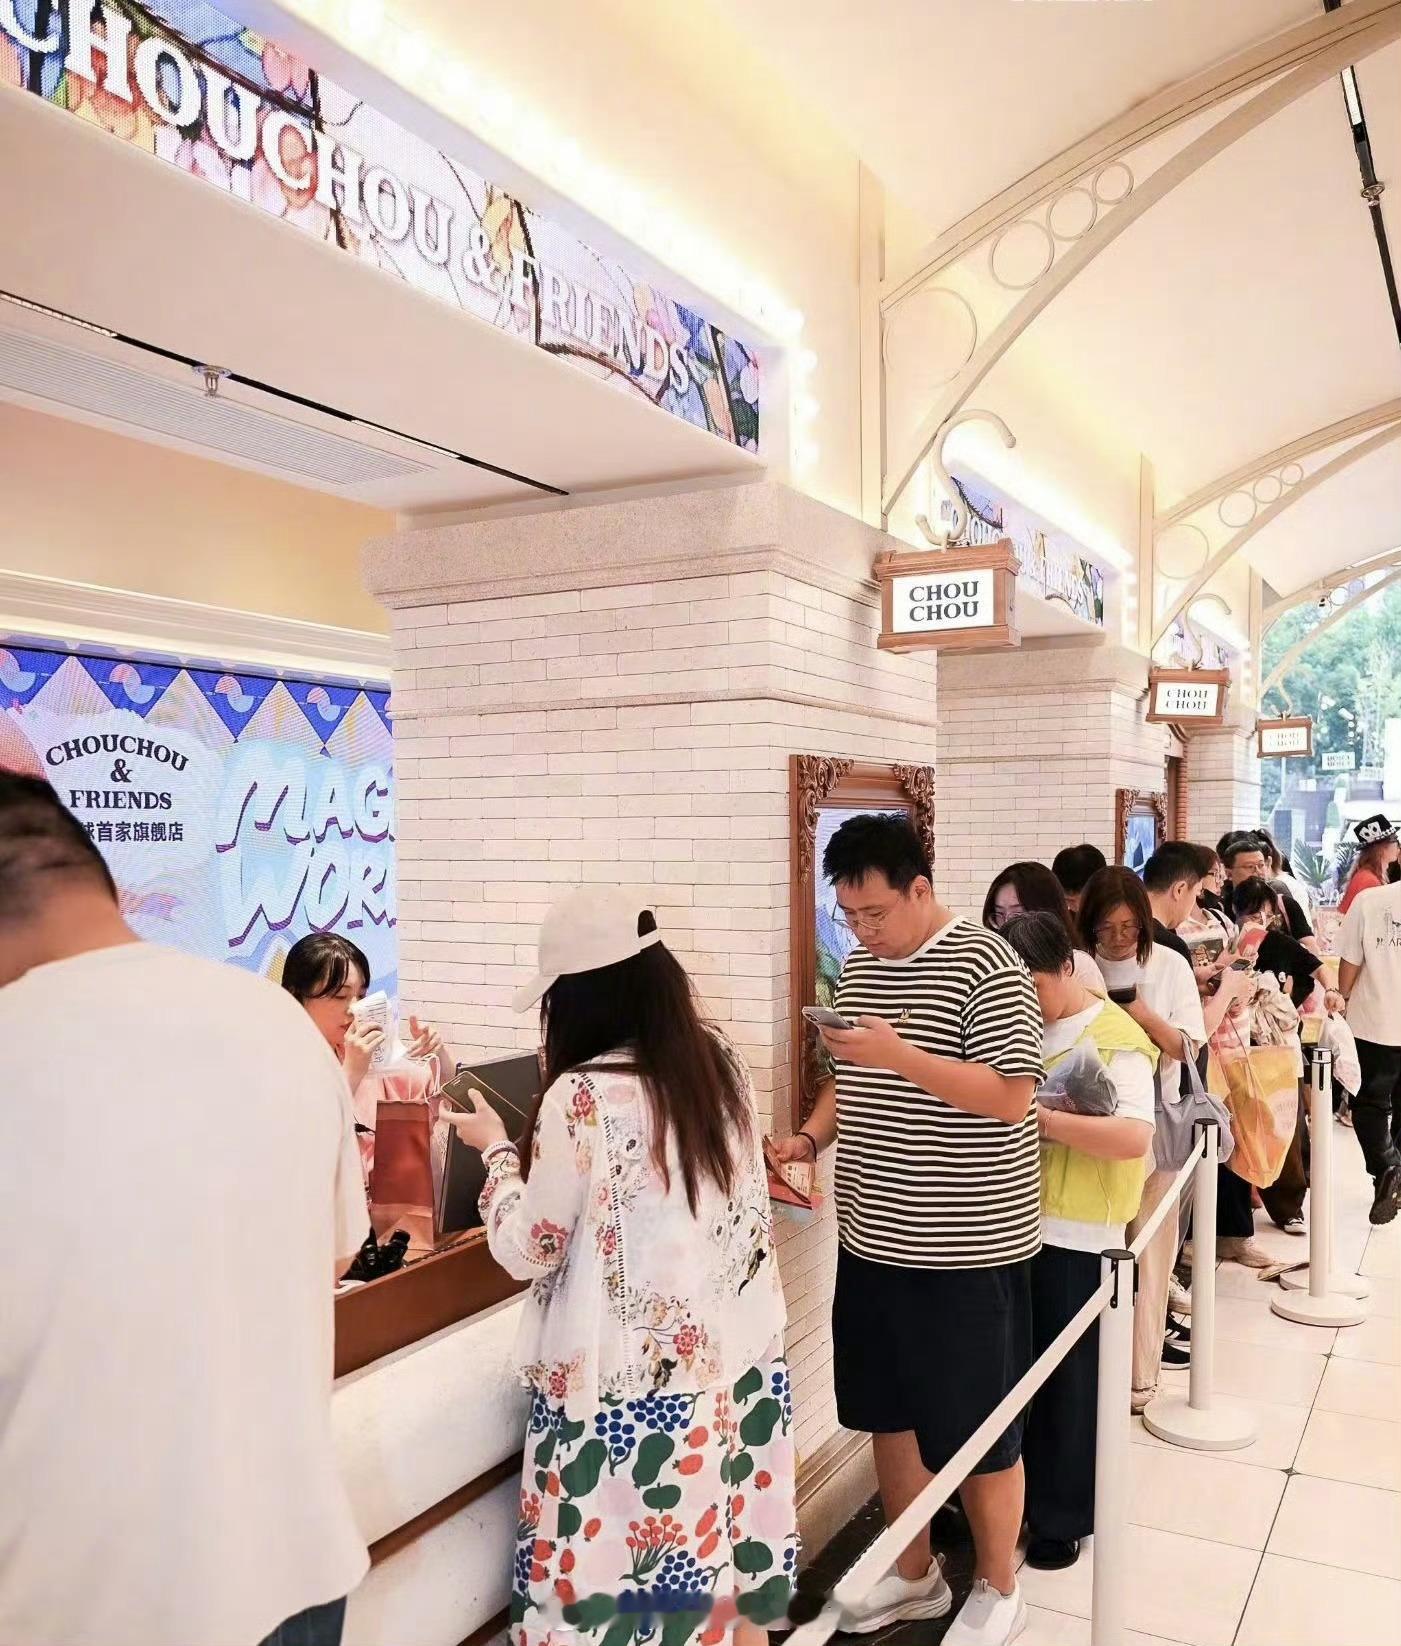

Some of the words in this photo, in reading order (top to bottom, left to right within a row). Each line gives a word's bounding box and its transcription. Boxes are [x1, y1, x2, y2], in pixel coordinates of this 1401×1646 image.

[509, 249, 690, 394] FRIENDS
[909, 581, 979, 602] CHOU
[909, 601, 979, 622] CHOU
[45, 734, 190, 772] CHOUCHOU
[110, 758, 133, 783] &
[69, 789, 172, 810] FRIENDS
[214, 742, 397, 853] MAG
[224, 848, 397, 948] WOR
